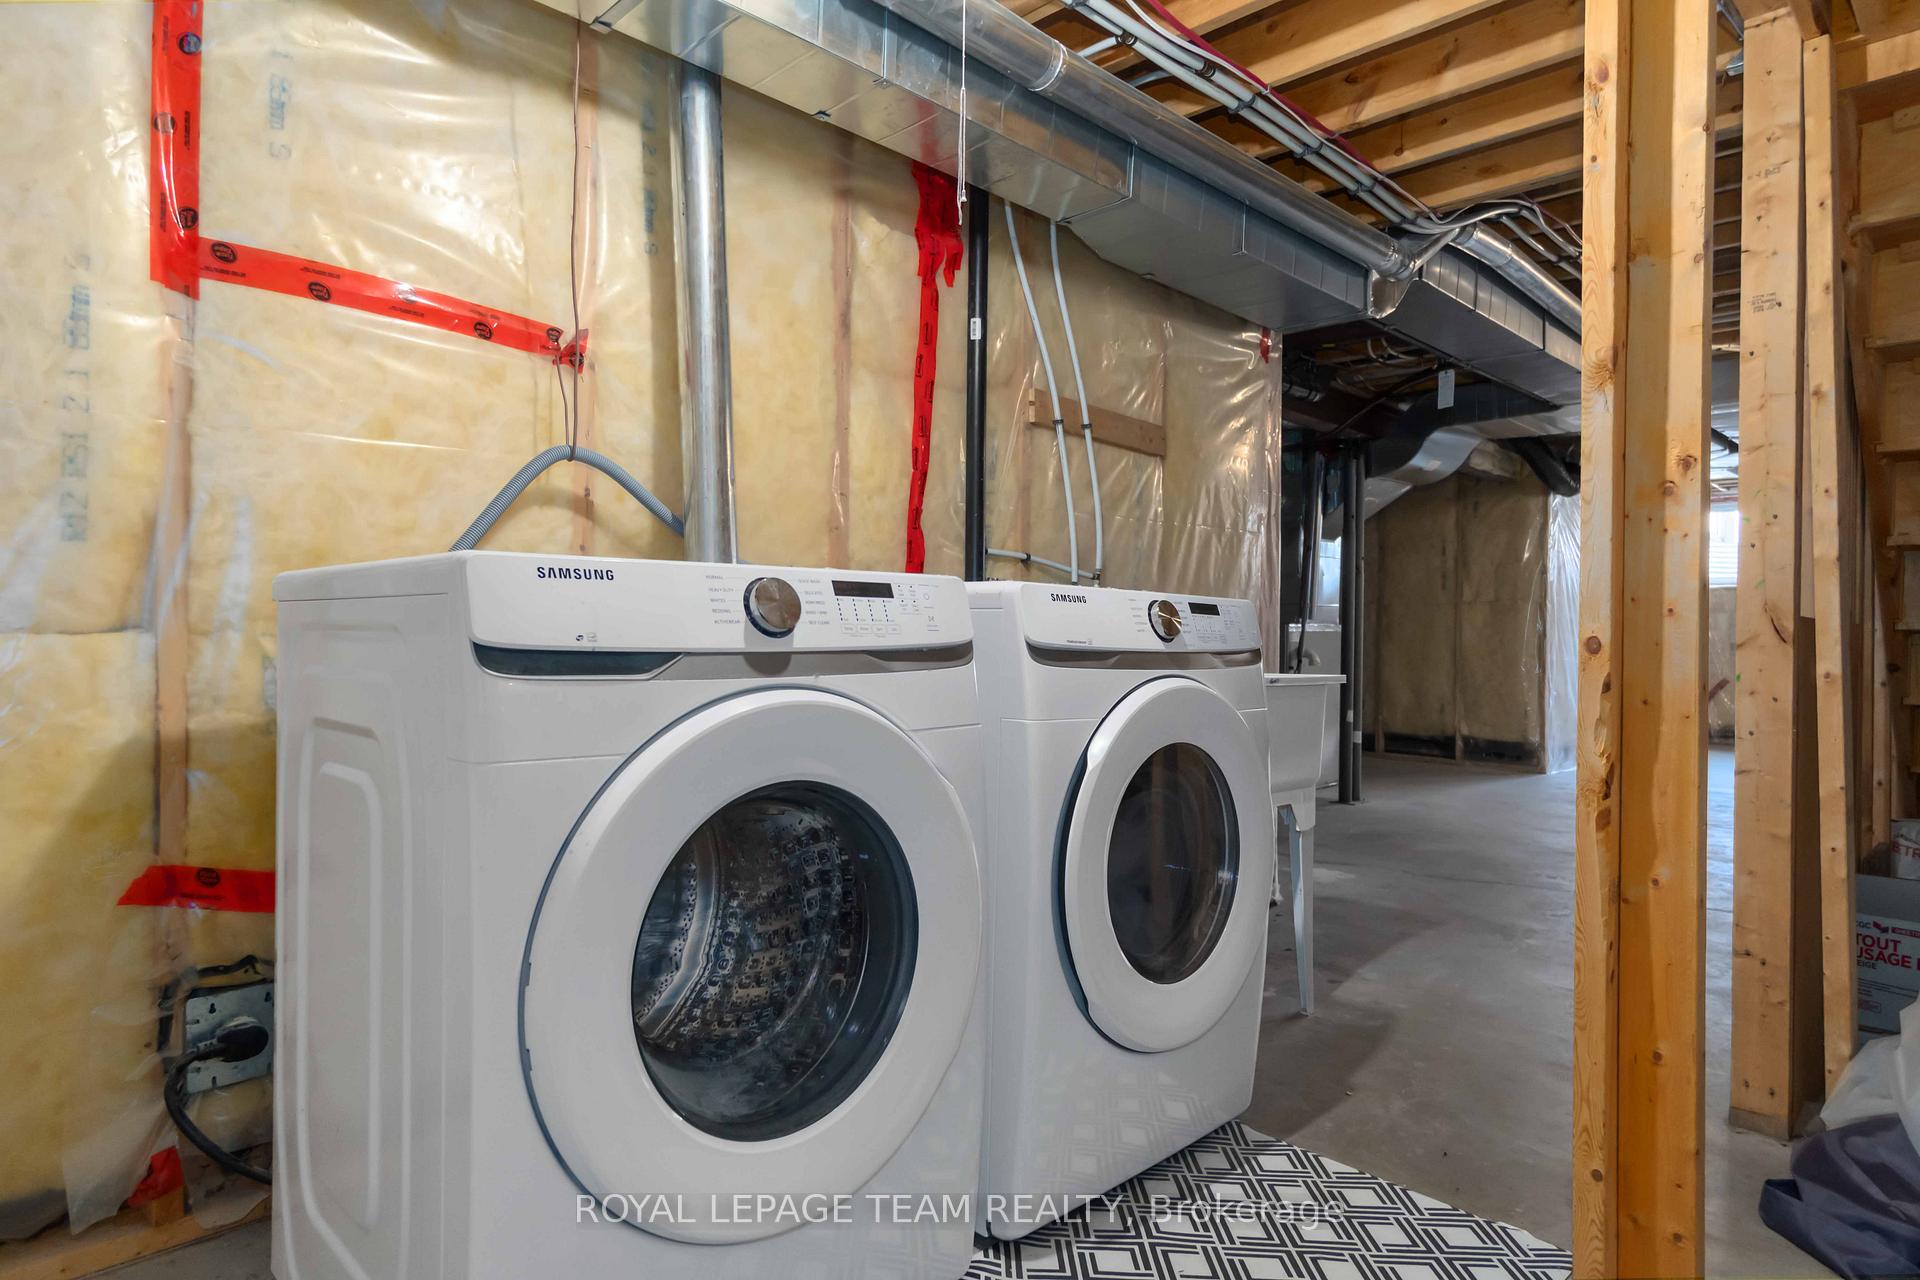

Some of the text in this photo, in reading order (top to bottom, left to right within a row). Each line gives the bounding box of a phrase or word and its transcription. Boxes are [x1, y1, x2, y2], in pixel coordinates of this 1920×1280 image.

[537, 566, 615, 581] SAMSUNG
[1050, 593, 1087, 604] SAMSUNG
[1856, 933, 1901, 955] TOUT
